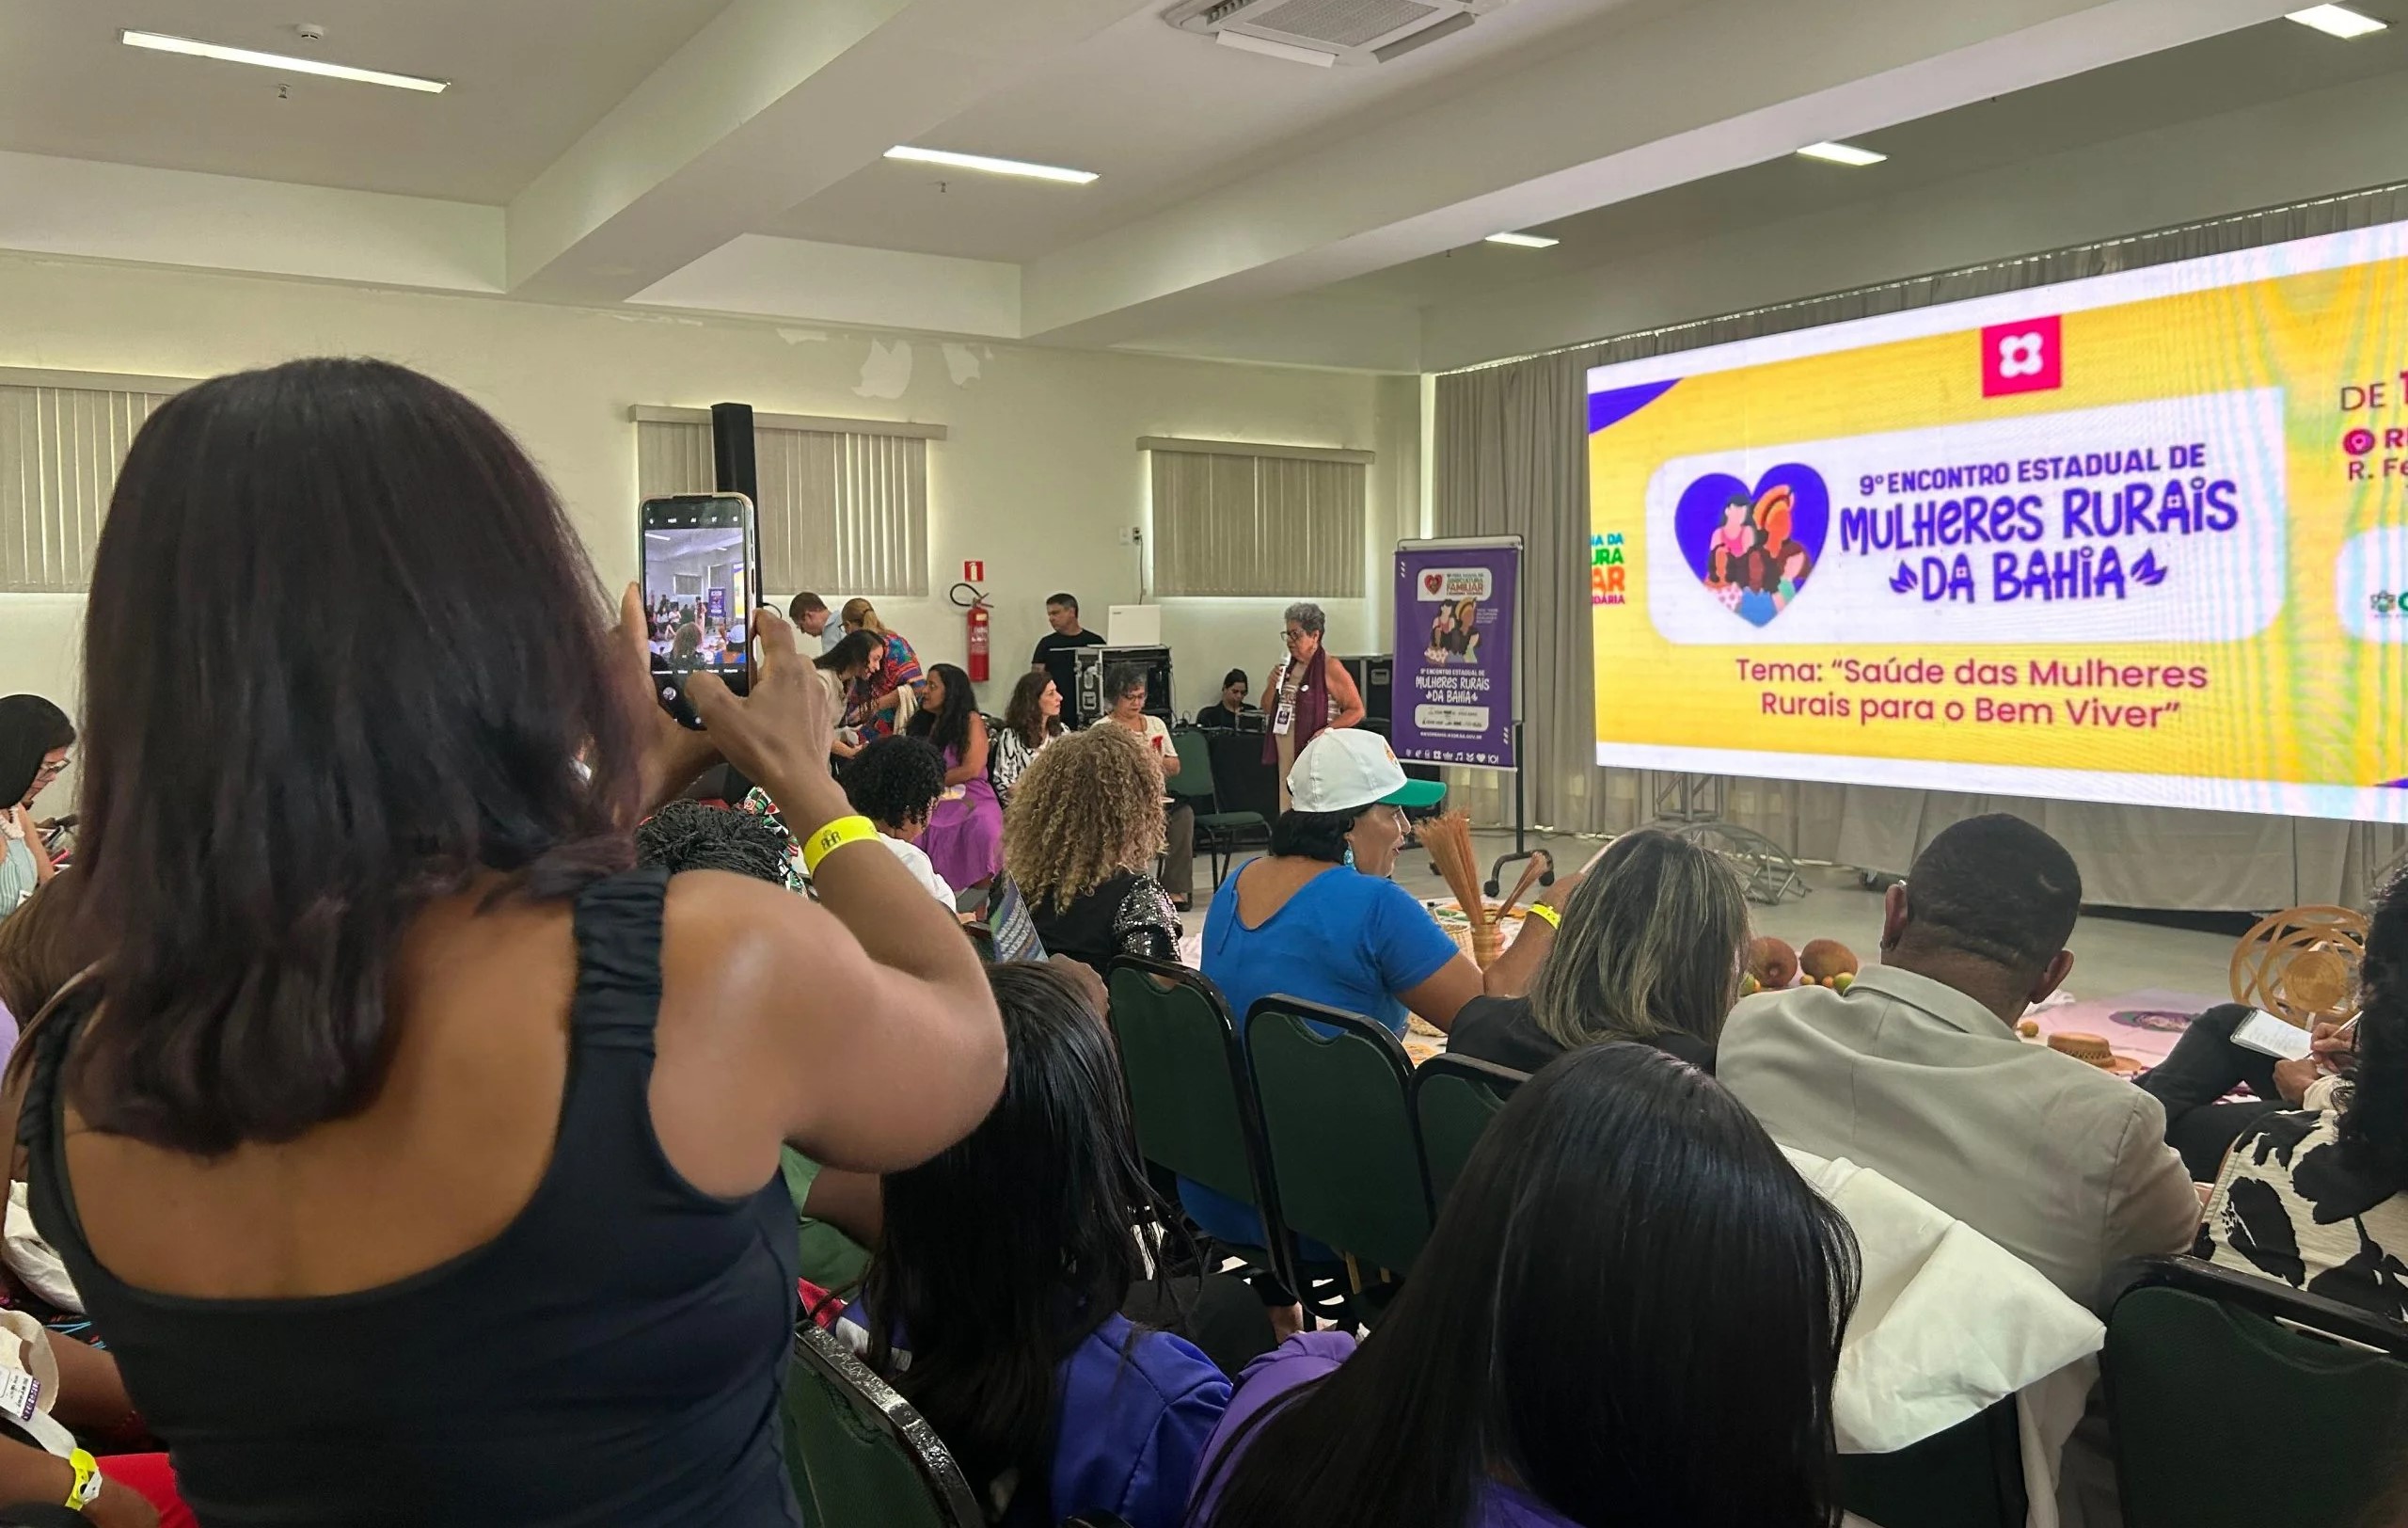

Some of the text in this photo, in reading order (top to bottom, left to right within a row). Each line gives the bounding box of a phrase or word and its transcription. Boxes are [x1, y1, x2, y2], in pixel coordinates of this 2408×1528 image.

[2341, 383, 2386, 411] DE
[1888, 462, 2010, 494] ENCONTRO
[2018, 448, 2161, 483] ESTADUAL
[2169, 443, 2206, 470] DE
[2349, 460, 2374, 481] R.
[1607, 533, 1624, 545] DA
[1922, 552, 1975, 603] DA
[1735, 657, 2209, 689] Tema: “Saúde das Mulheres
[1432, 689, 1444, 703] DA
[1762, 692, 2180, 728] Rurais para o Bem Viver”
